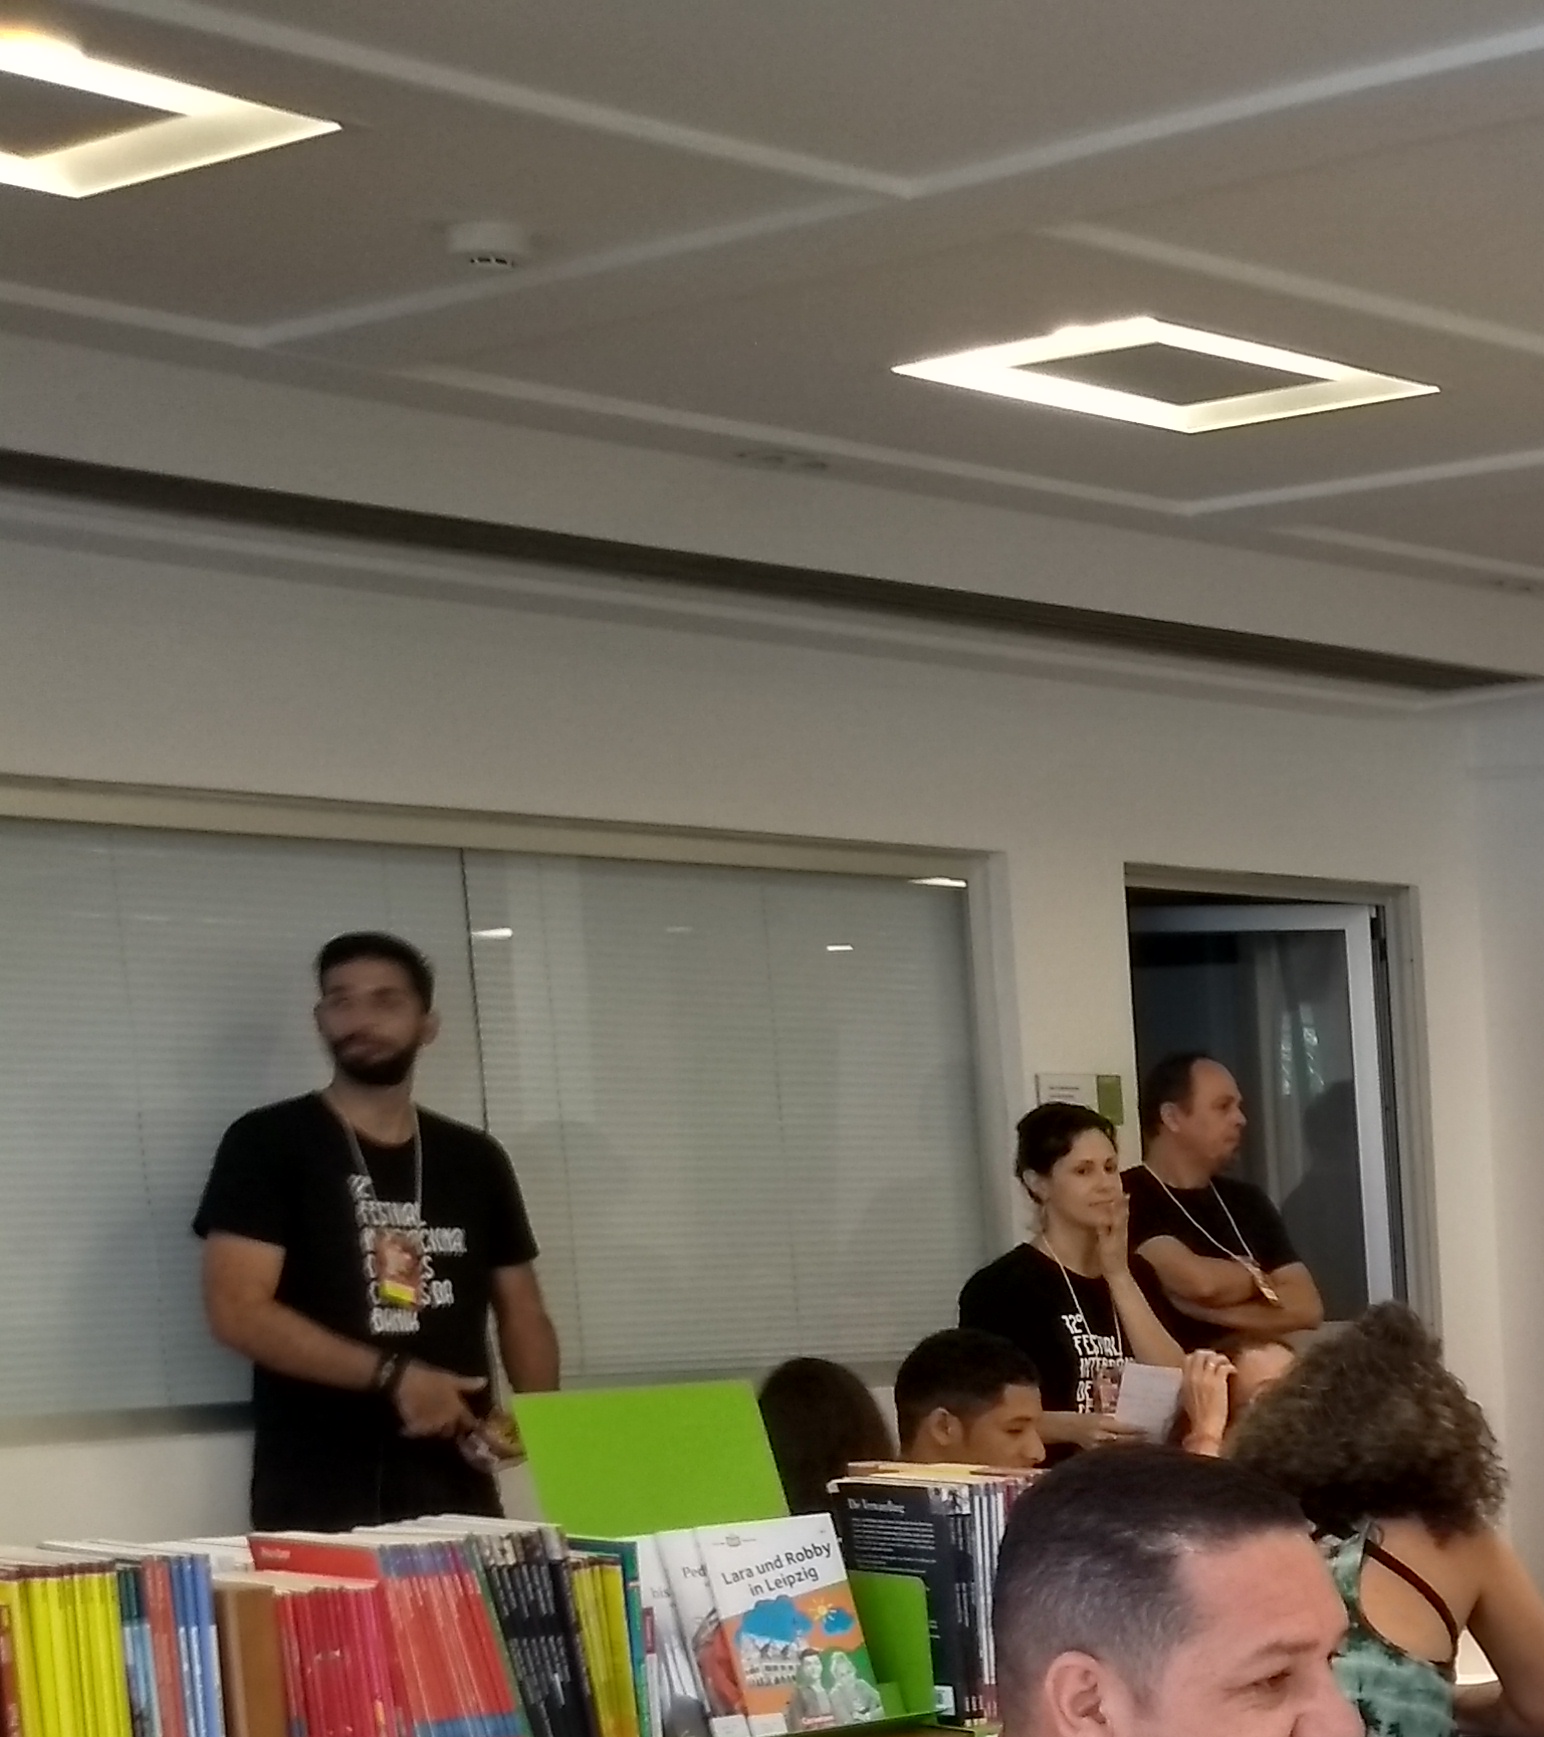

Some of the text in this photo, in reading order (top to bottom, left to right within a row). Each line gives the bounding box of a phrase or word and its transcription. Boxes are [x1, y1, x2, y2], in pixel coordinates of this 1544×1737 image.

[722, 1566, 754, 1586] Lara
[755, 1555, 784, 1575] und
[785, 1542, 832, 1566] Robby
[749, 1567, 819, 1597] in Leipzig
